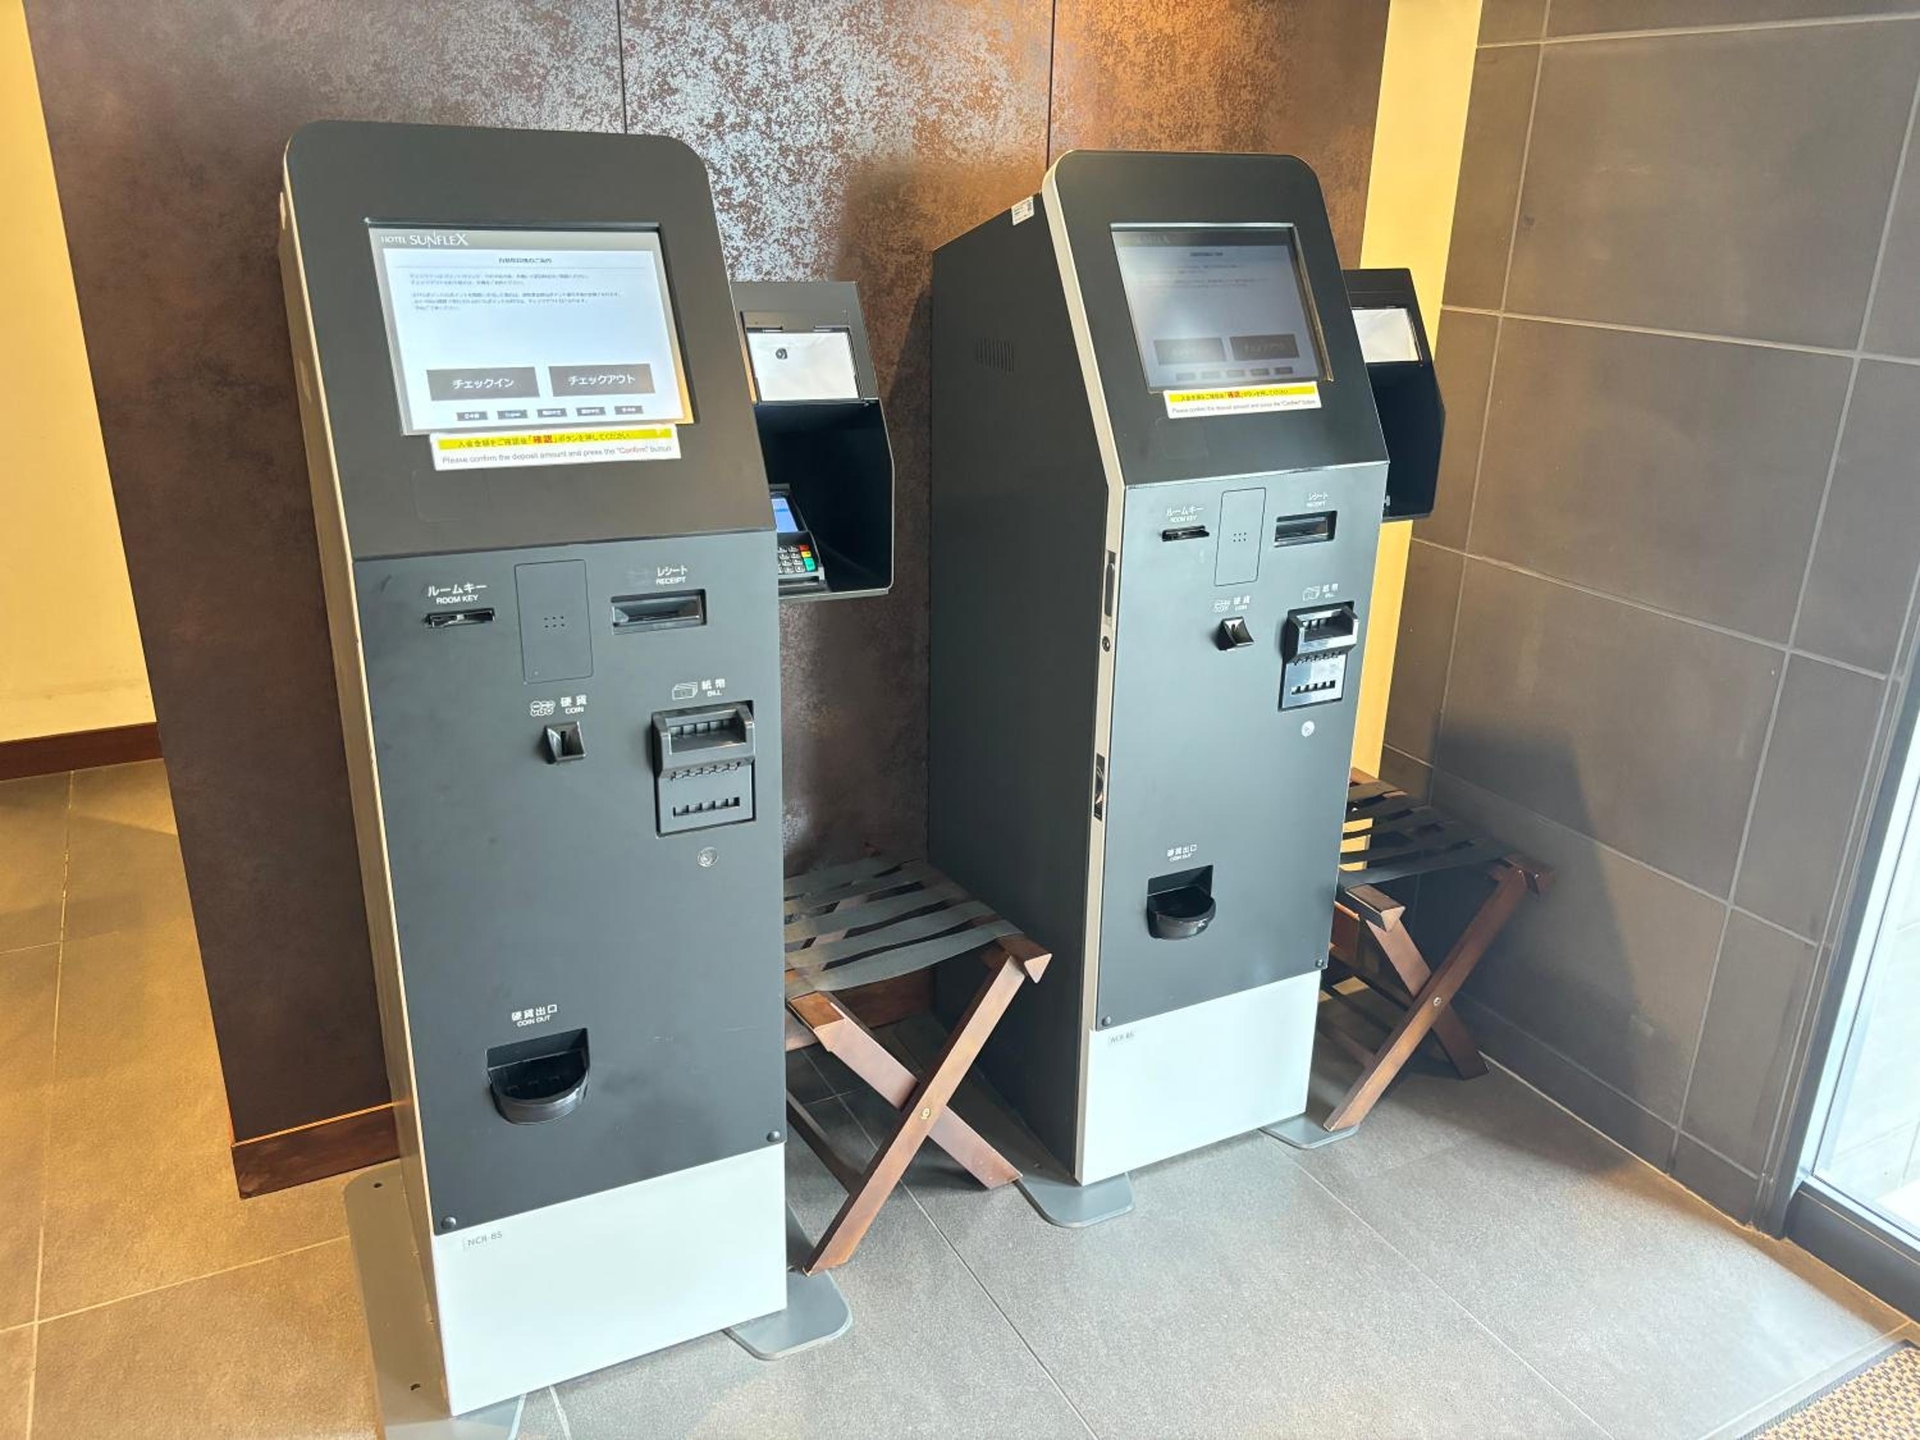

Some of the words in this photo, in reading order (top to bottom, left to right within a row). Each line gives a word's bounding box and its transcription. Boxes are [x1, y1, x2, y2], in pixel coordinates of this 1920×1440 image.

[409, 230, 469, 248] SUNFLEX
[453, 378, 514, 389] チェックイン
[568, 374, 636, 386] チェックアウト
[442, 456, 468, 464] Please
[469, 454, 497, 463] confirm
[498, 453, 511, 461] the
[511, 452, 538, 462] deposit
[540, 451, 566, 459] amount
[568, 449, 581, 457] and
[583, 449, 602, 459] press
[657, 564, 688, 576] レシート
[655, 576, 686, 585] RECEIPT
[428, 582, 487, 597] ルームキー
[436, 596, 461, 604] ROOM
[565, 706, 584, 714] COIN
[516, 1018, 535, 1027] COIN
[536, 1014, 551, 1023] OUT
